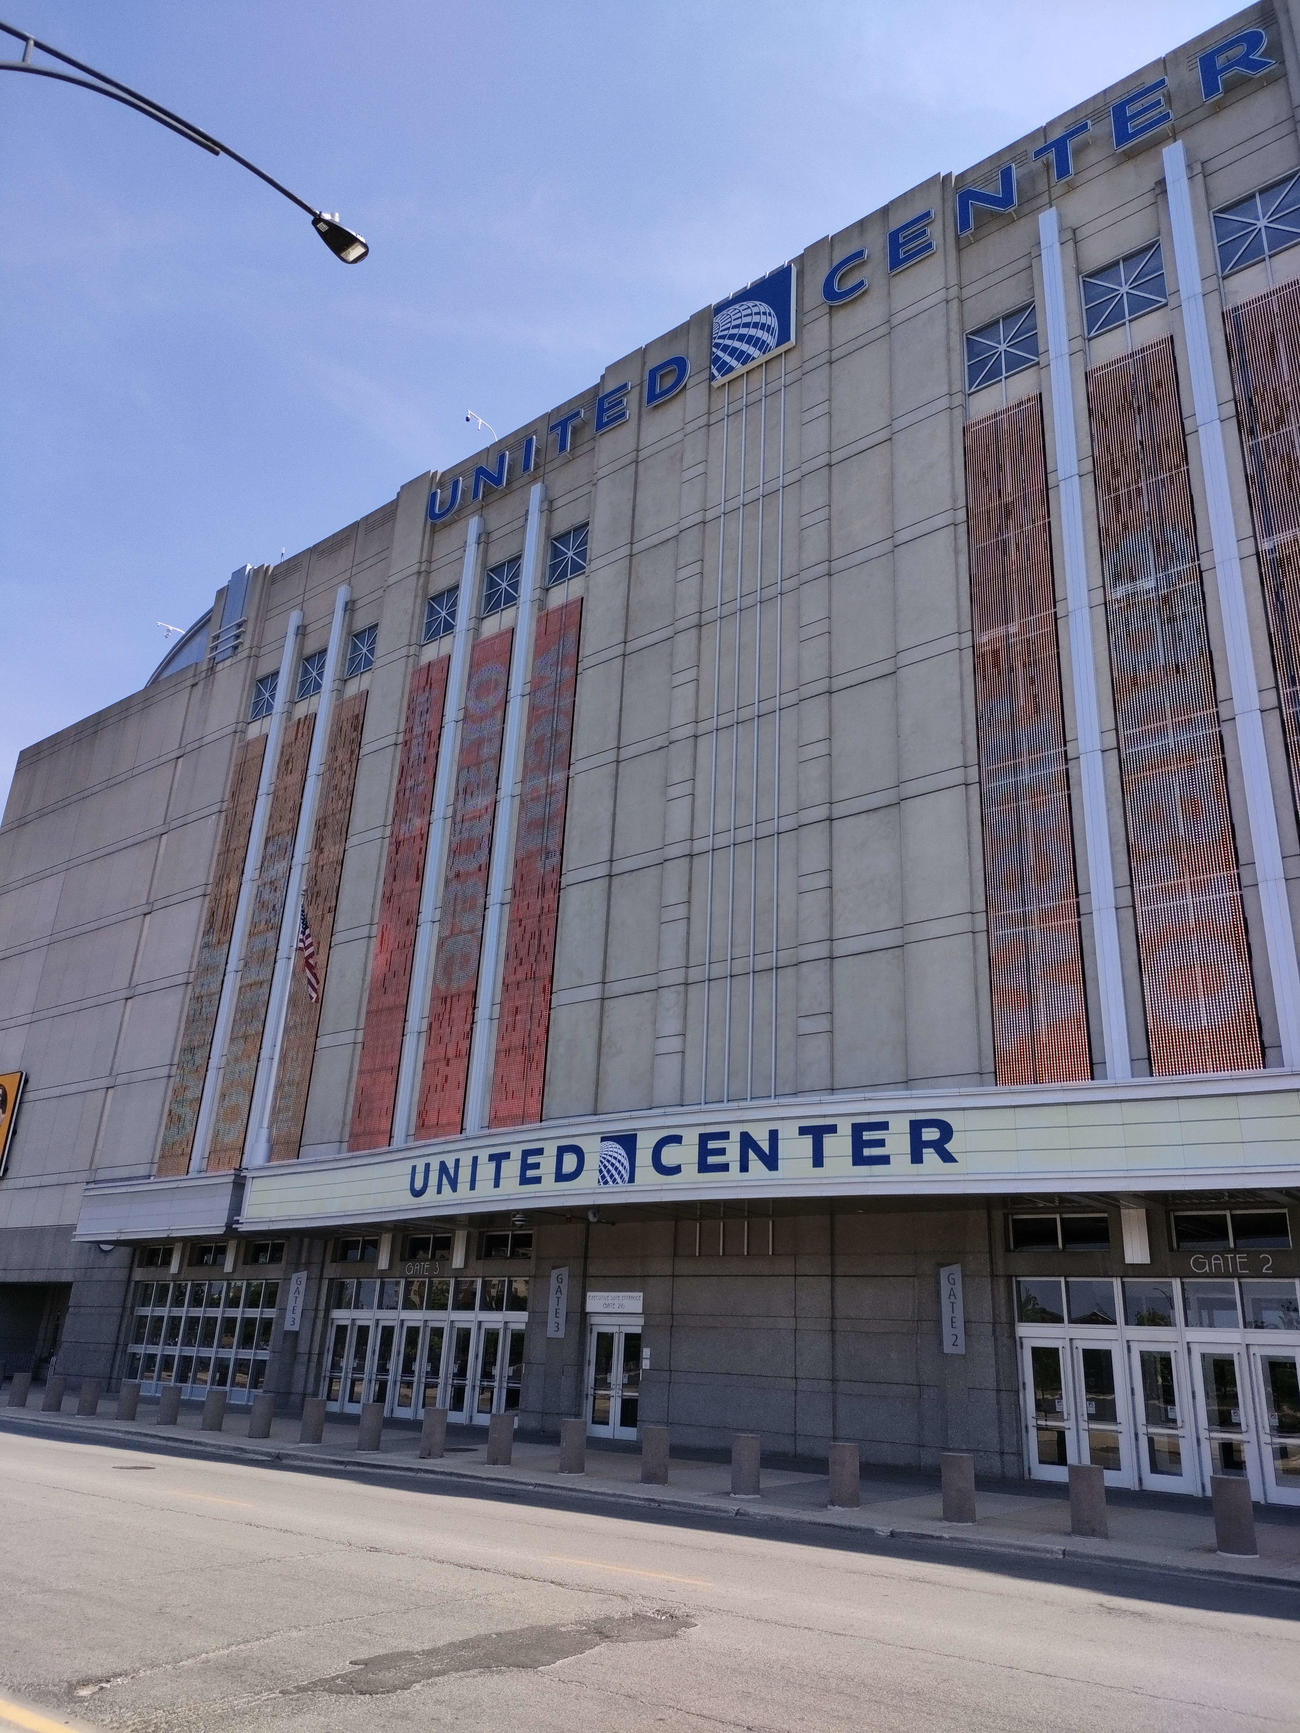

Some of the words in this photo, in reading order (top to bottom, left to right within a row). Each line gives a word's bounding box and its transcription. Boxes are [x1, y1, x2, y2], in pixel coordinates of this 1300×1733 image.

[427, 354, 691, 523] UNITED
[821, 28, 1277, 305] CENTER
[409, 1143, 585, 1198] UNITED
[651, 1118, 958, 1177] CENTER
[405, 1262, 430, 1275] GATE
[433, 1261, 440, 1275] 3
[1190, 1254, 1249, 1273] GATE
[1259, 1254, 1273, 1273] 2
[292, 1276, 302, 1315] GATE
[555, 1273, 564, 1319] GATE
[947, 1272, 957, 1329] GATE
[290, 1316, 296, 1326] 3
[554, 1321, 560, 1332] 3
[951, 1333, 959, 1347] 2
